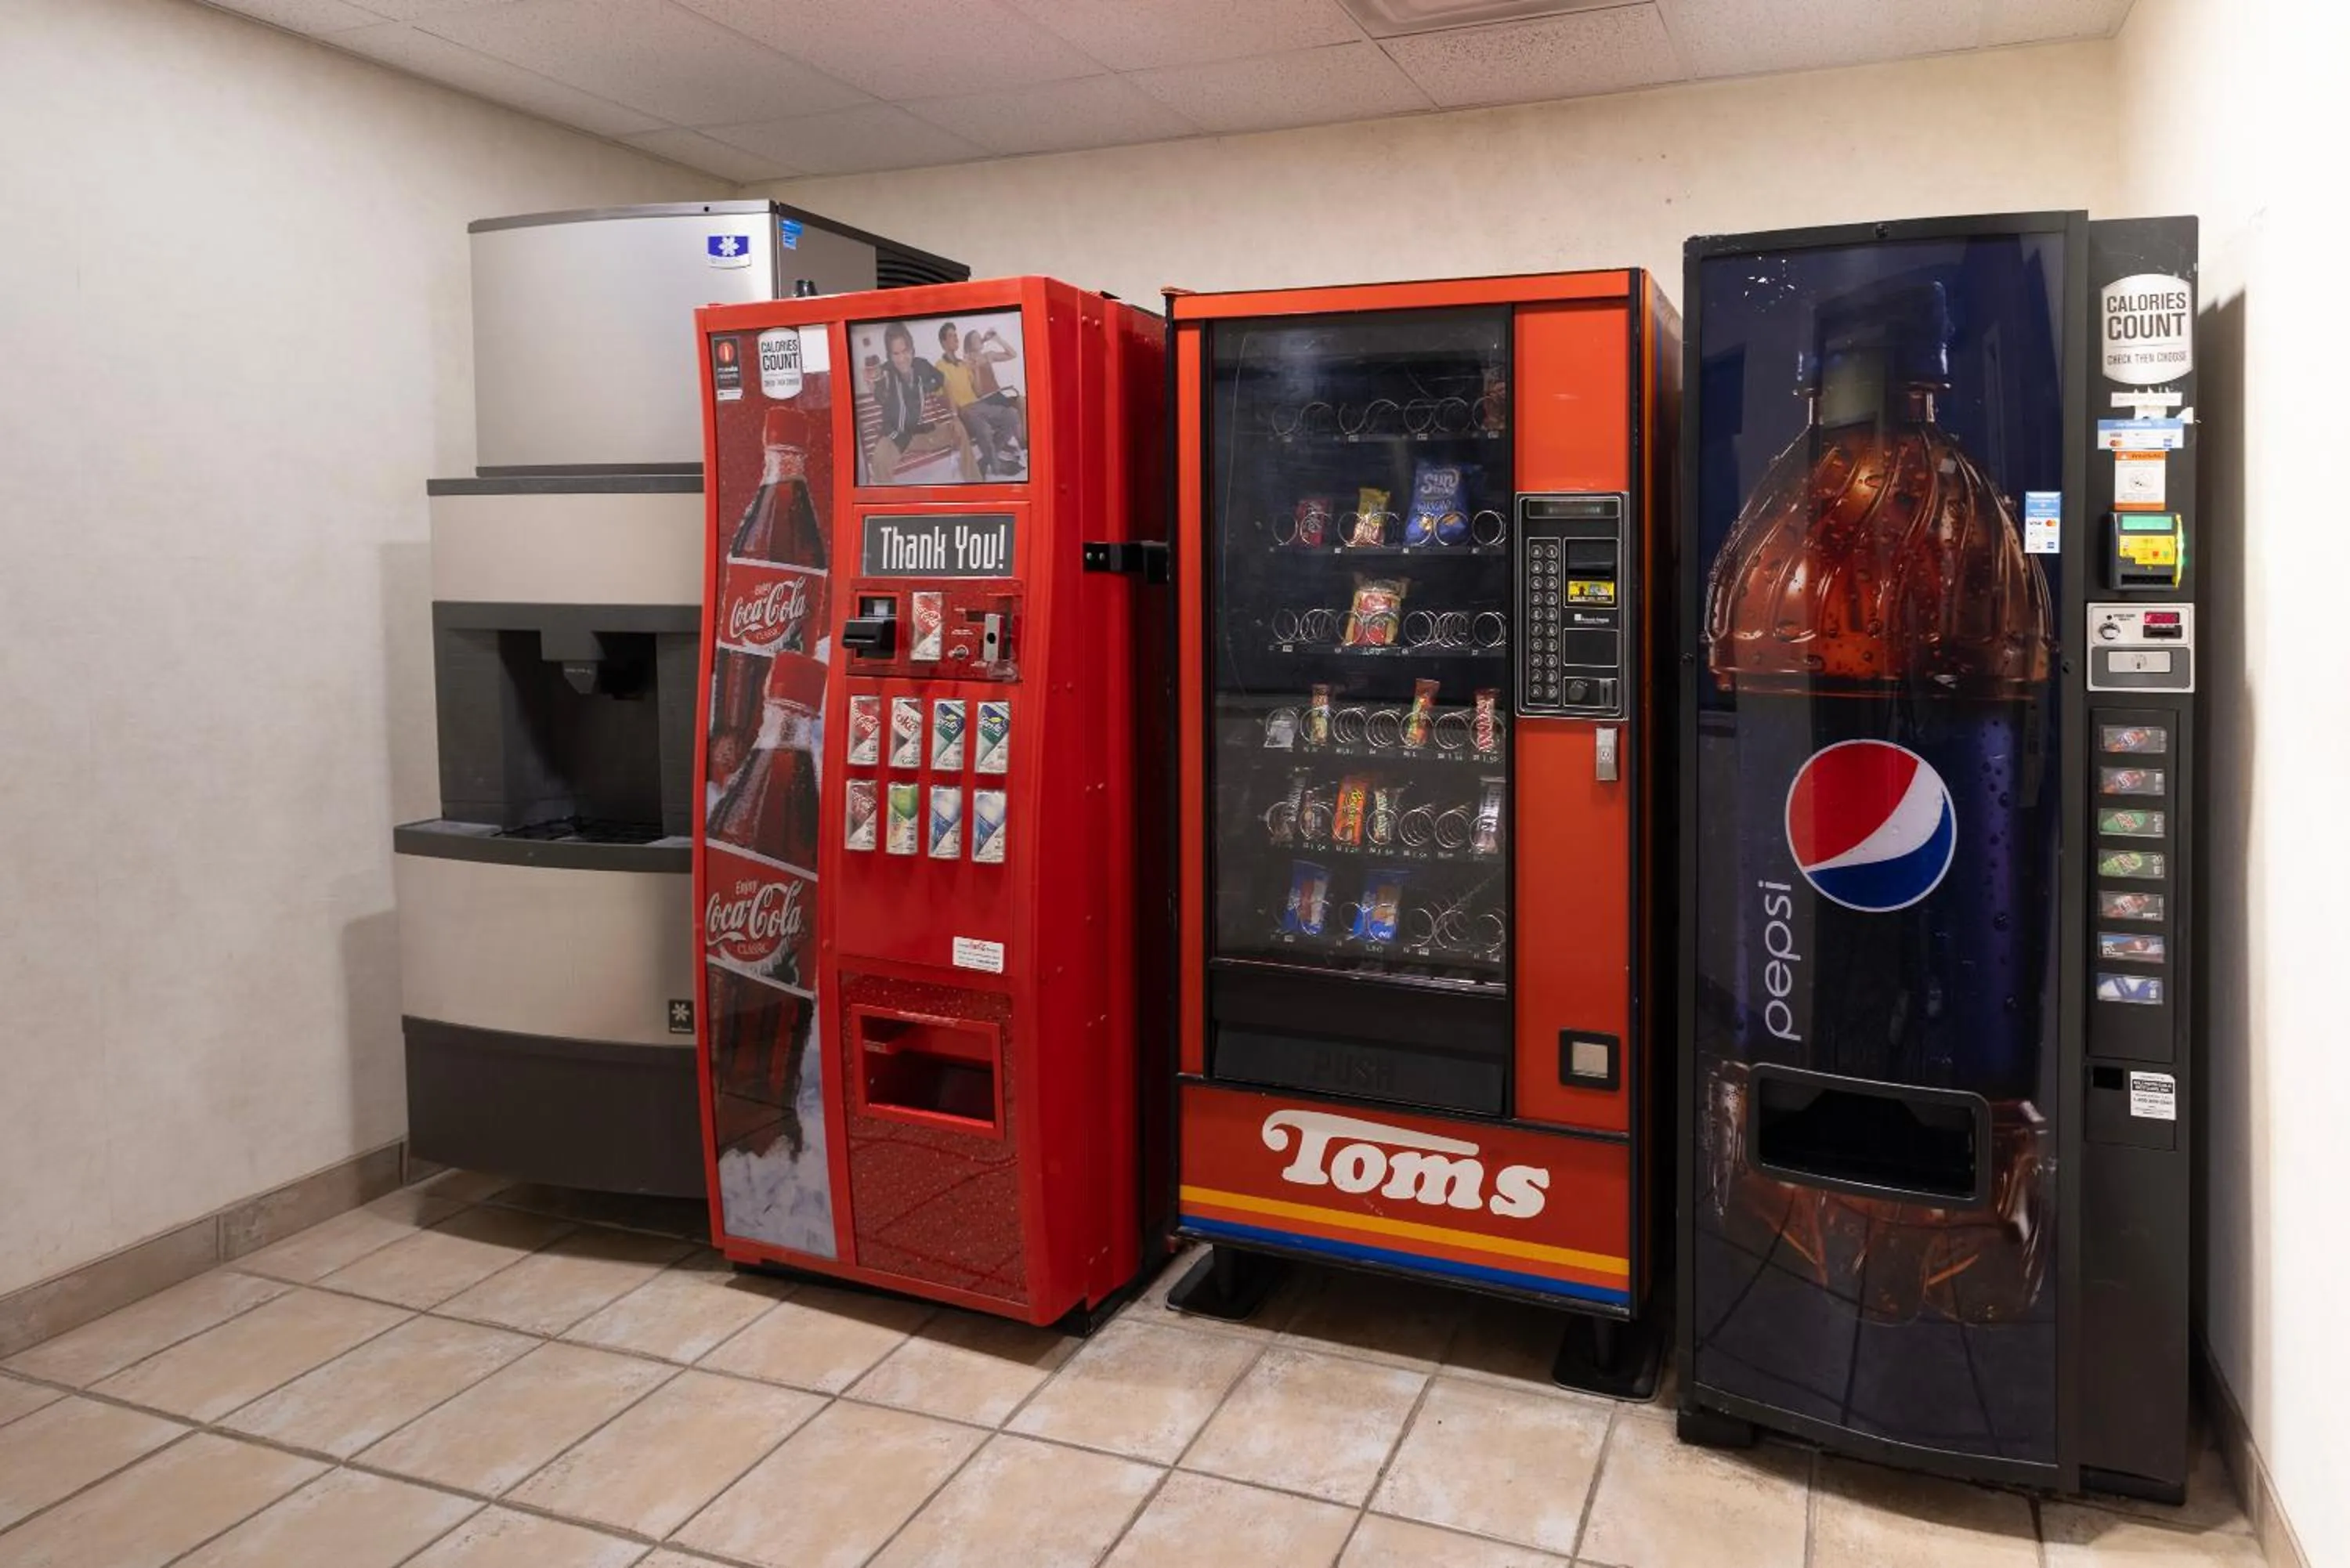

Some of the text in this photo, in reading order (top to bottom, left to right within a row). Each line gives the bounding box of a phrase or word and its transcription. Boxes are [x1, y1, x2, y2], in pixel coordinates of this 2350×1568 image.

[2106, 292, 2186, 313] CALORIES
[2107, 313, 2186, 340] COUNT
[761, 339, 798, 352] CALORIES
[762, 353, 798, 370] COUNT
[2107, 355, 2132, 366] CHECK
[2135, 353, 2155, 363] THEN
[880, 524, 1006, 569] Thank You!
[729, 576, 805, 638] Coca-Cola
[706, 880, 803, 946] Coca-Cola
[1758, 880, 1802, 1041] pepsi
[1262, 1109, 1550, 1219] Toms
